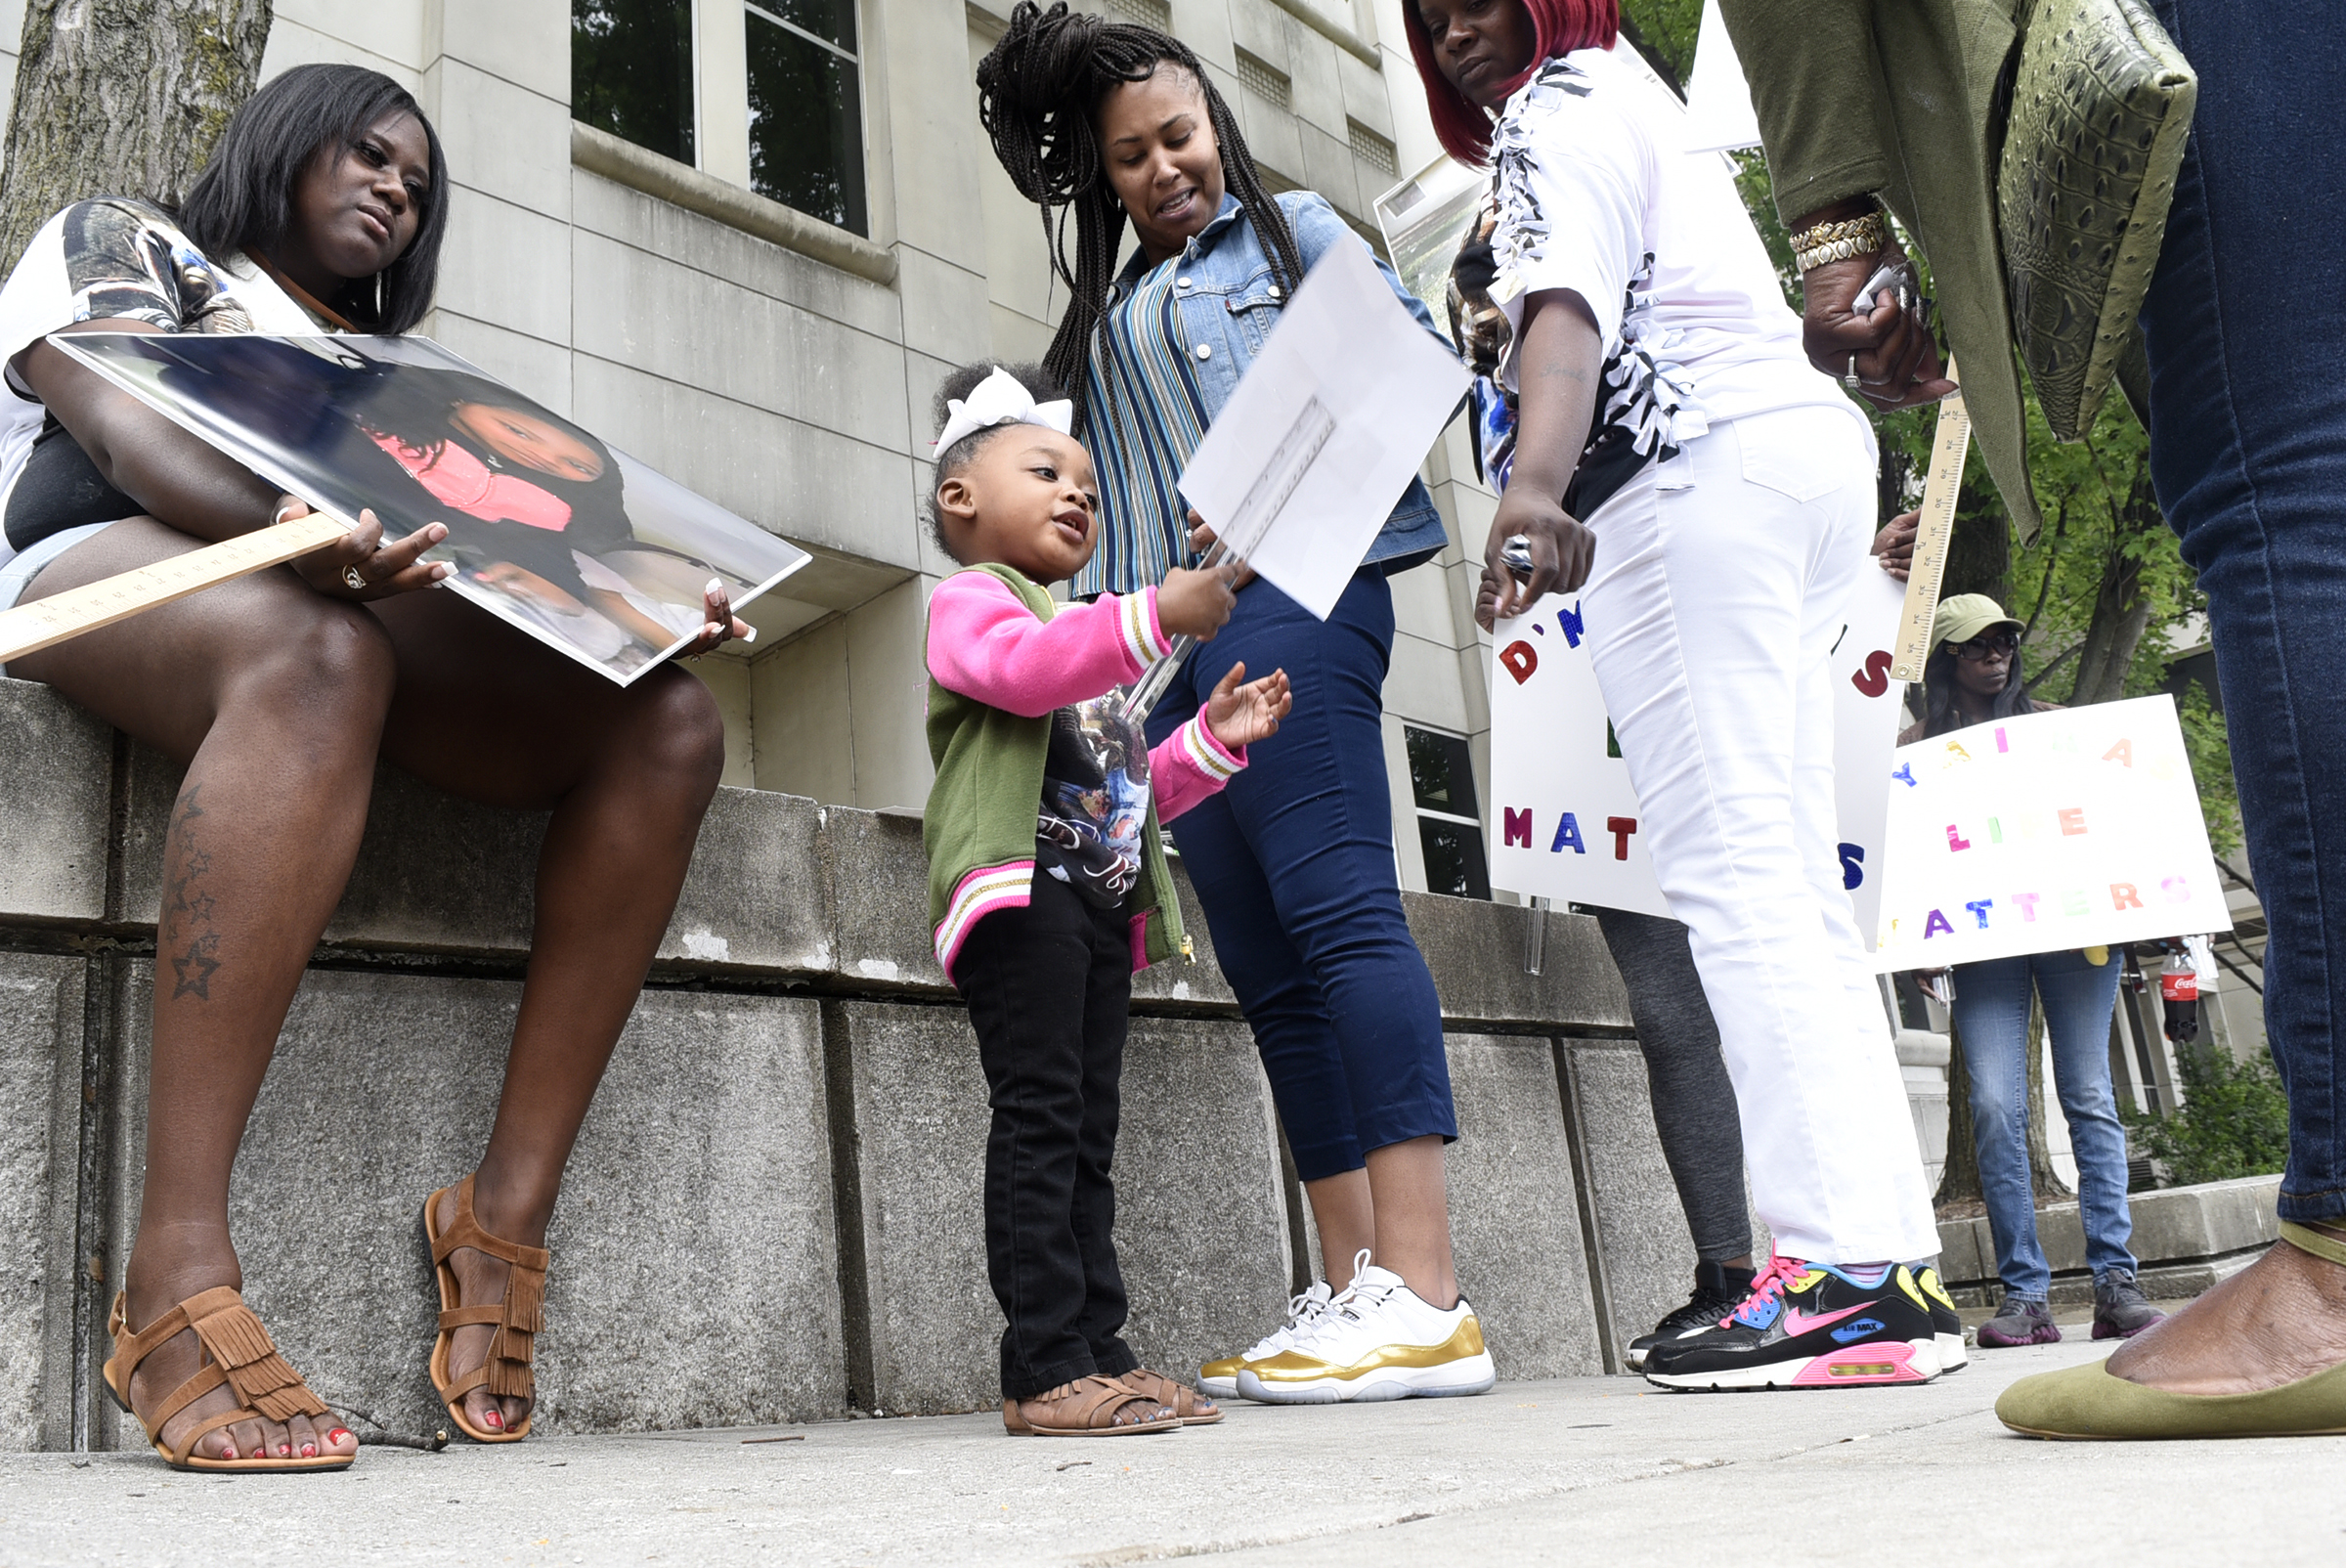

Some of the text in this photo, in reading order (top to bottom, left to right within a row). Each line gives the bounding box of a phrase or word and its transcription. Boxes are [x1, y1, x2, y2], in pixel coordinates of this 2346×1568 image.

[1951, 410, 1959, 420] 27
[1934, 497, 1942, 508] 30
[1929, 526, 1936, 537] 31
[1923, 555, 1932, 567] 32
[1918, 585, 1926, 595] 33
[1857, 1322, 1878, 1332] MAX
